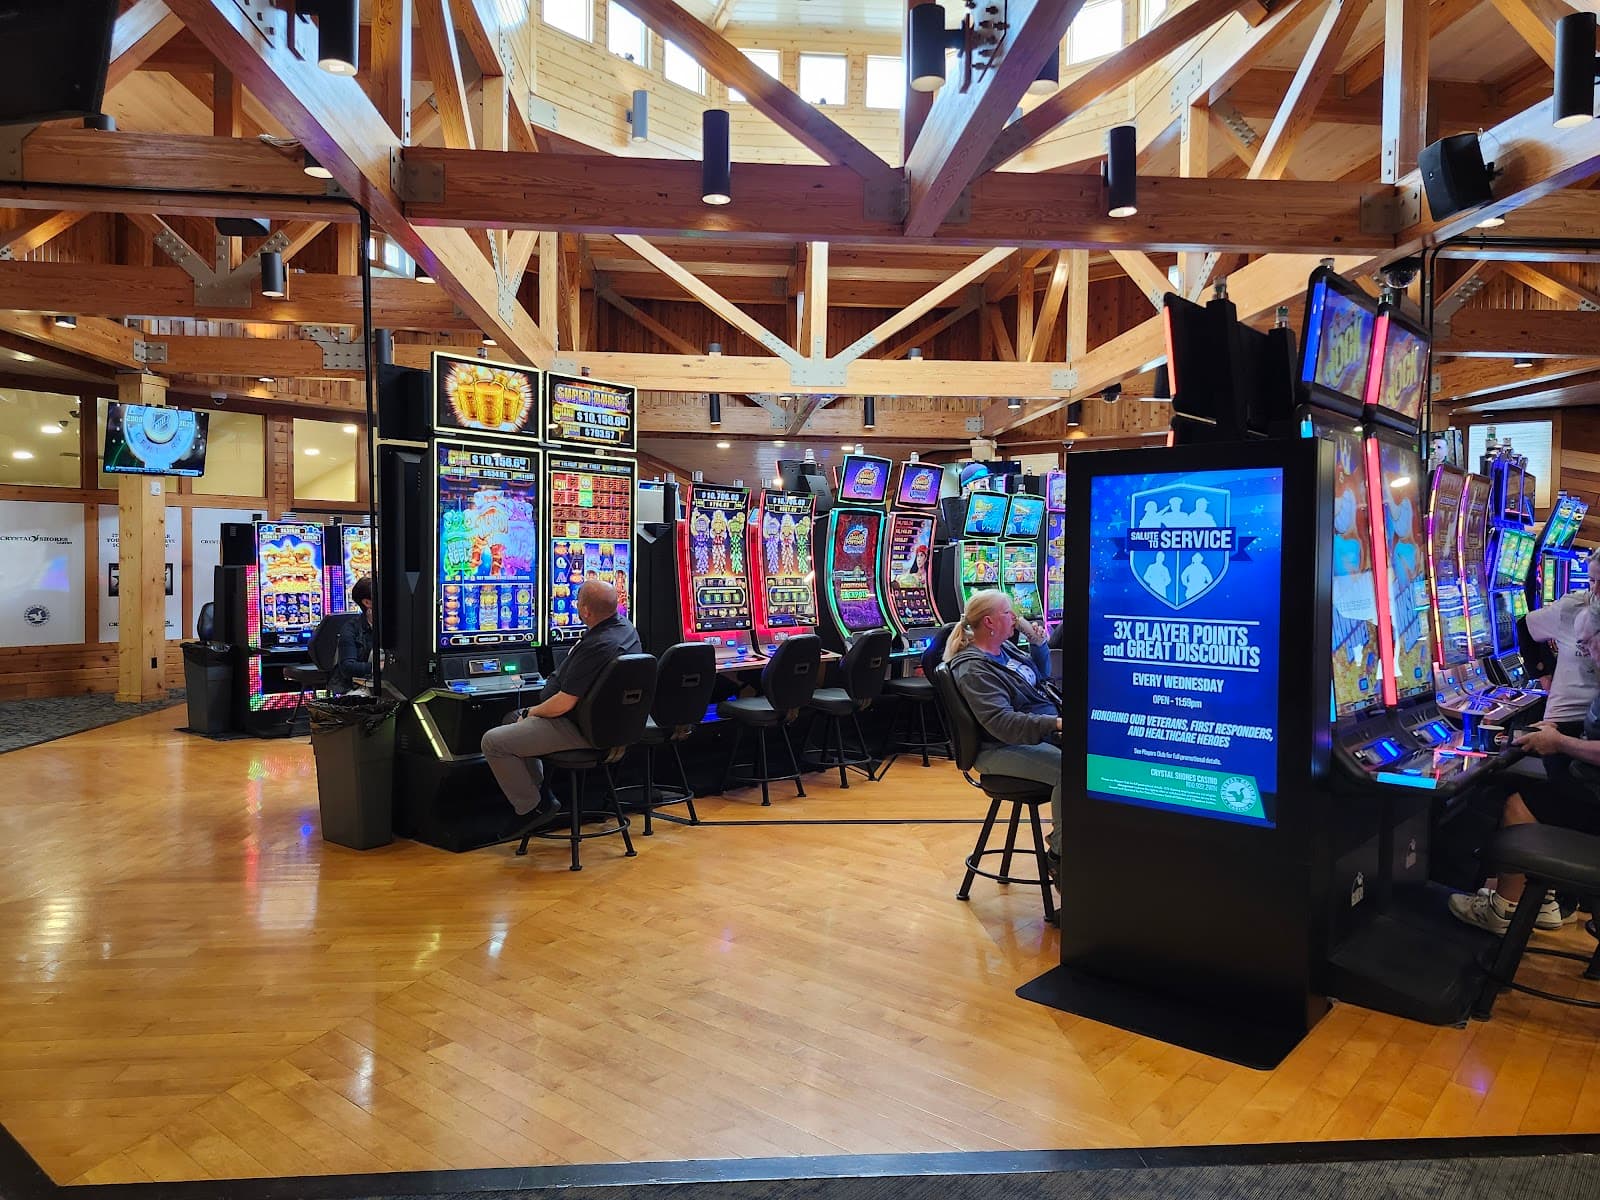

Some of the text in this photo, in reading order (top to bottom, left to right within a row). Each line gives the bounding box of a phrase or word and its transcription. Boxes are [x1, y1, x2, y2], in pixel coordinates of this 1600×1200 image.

[556, 386, 591, 403] SUPER
[1130, 531, 1160, 541] SALUTE
[1148, 540, 1159, 549] TO
[1160, 529, 1233, 549] SERVICE
[1113, 621, 1249, 647] 3X PLAYER POINTS
[1103, 639, 1261, 667] and GREAT DISCOUNTS
[1132, 672, 1224, 693] EVERY WEDNESDAY
[1152, 694, 1170, 705] OPEN
[1175, 696, 1202, 709] 11:59pm
[1090, 709, 1274, 742] HONORING OUR VETERANS, FIRST RESPONDERS,
[1127, 725, 1231, 748] AND HEALTHCARE HEROES
[1150, 768, 1218, 785] CRYSTAL SHORES CASINO
